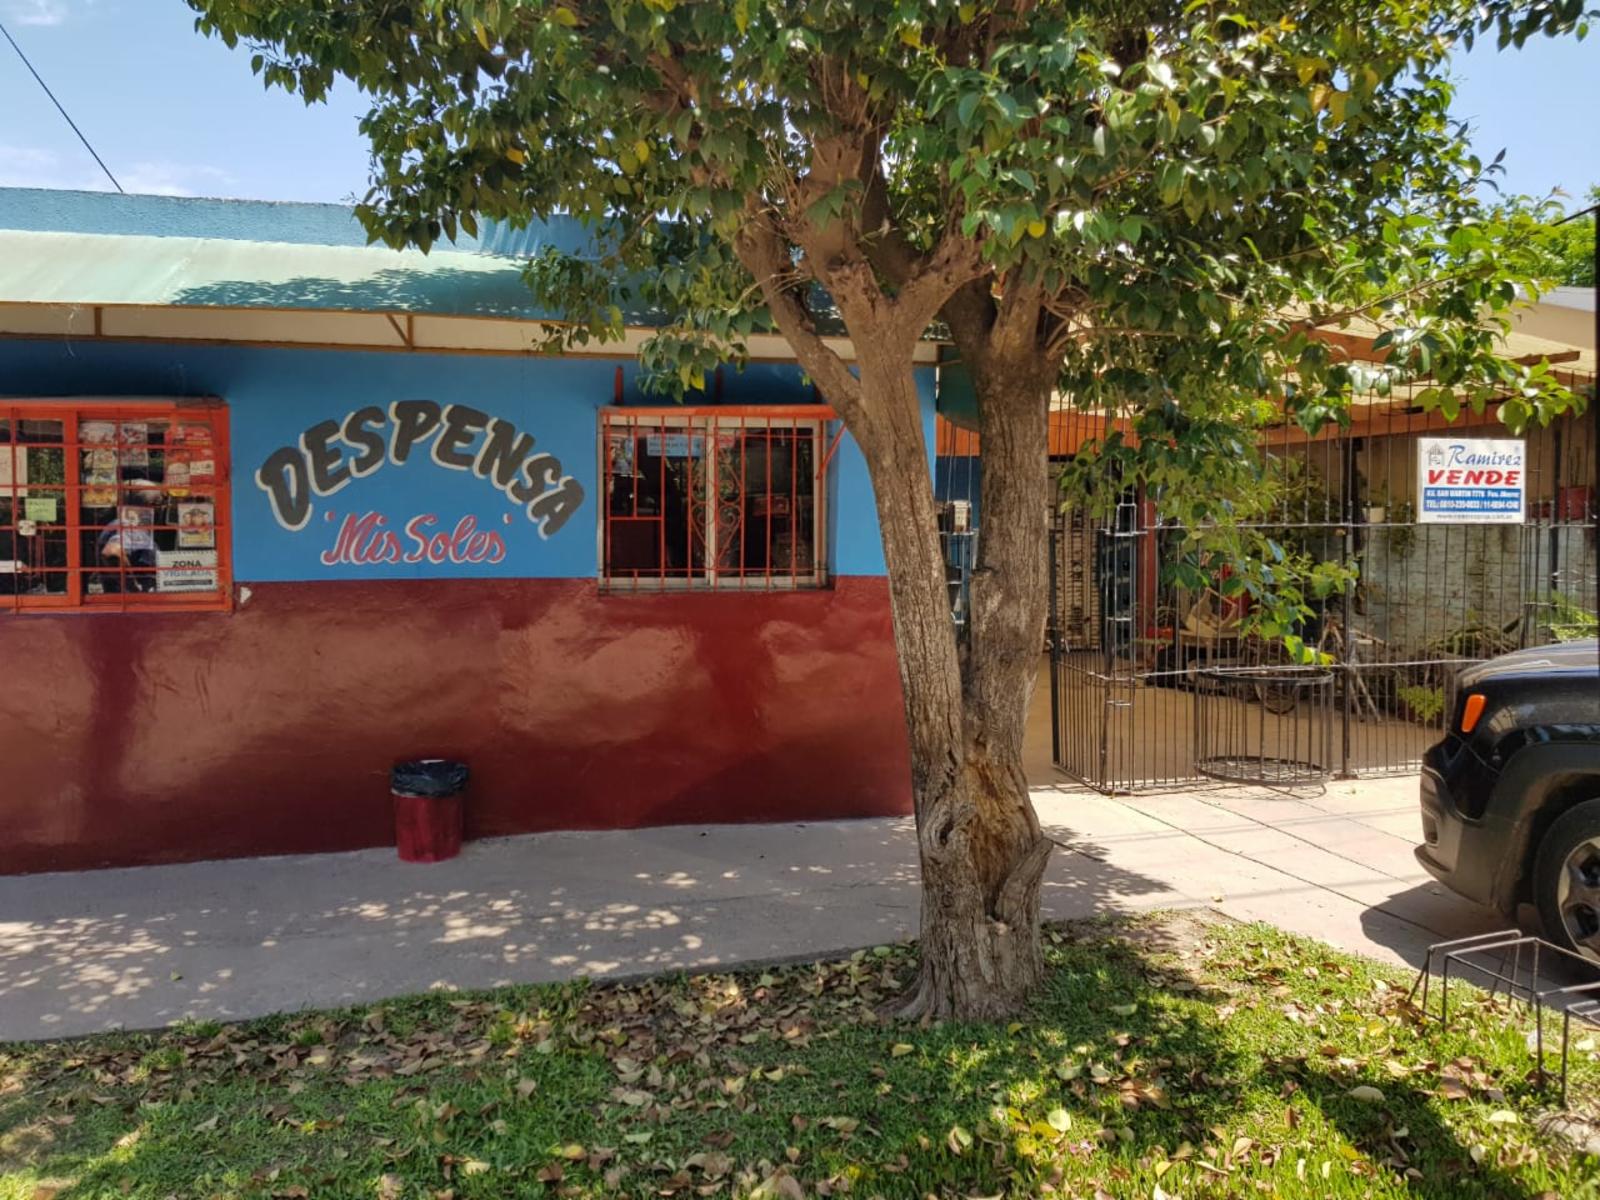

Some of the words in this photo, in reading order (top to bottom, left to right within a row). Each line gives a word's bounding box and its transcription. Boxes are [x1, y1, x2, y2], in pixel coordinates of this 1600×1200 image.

[1447, 445, 1521, 467] Ramirez
[255, 400, 585, 540] DESPENSA
[1428, 469, 1521, 486] VENDE
[172, 560, 202, 569] ZONA
